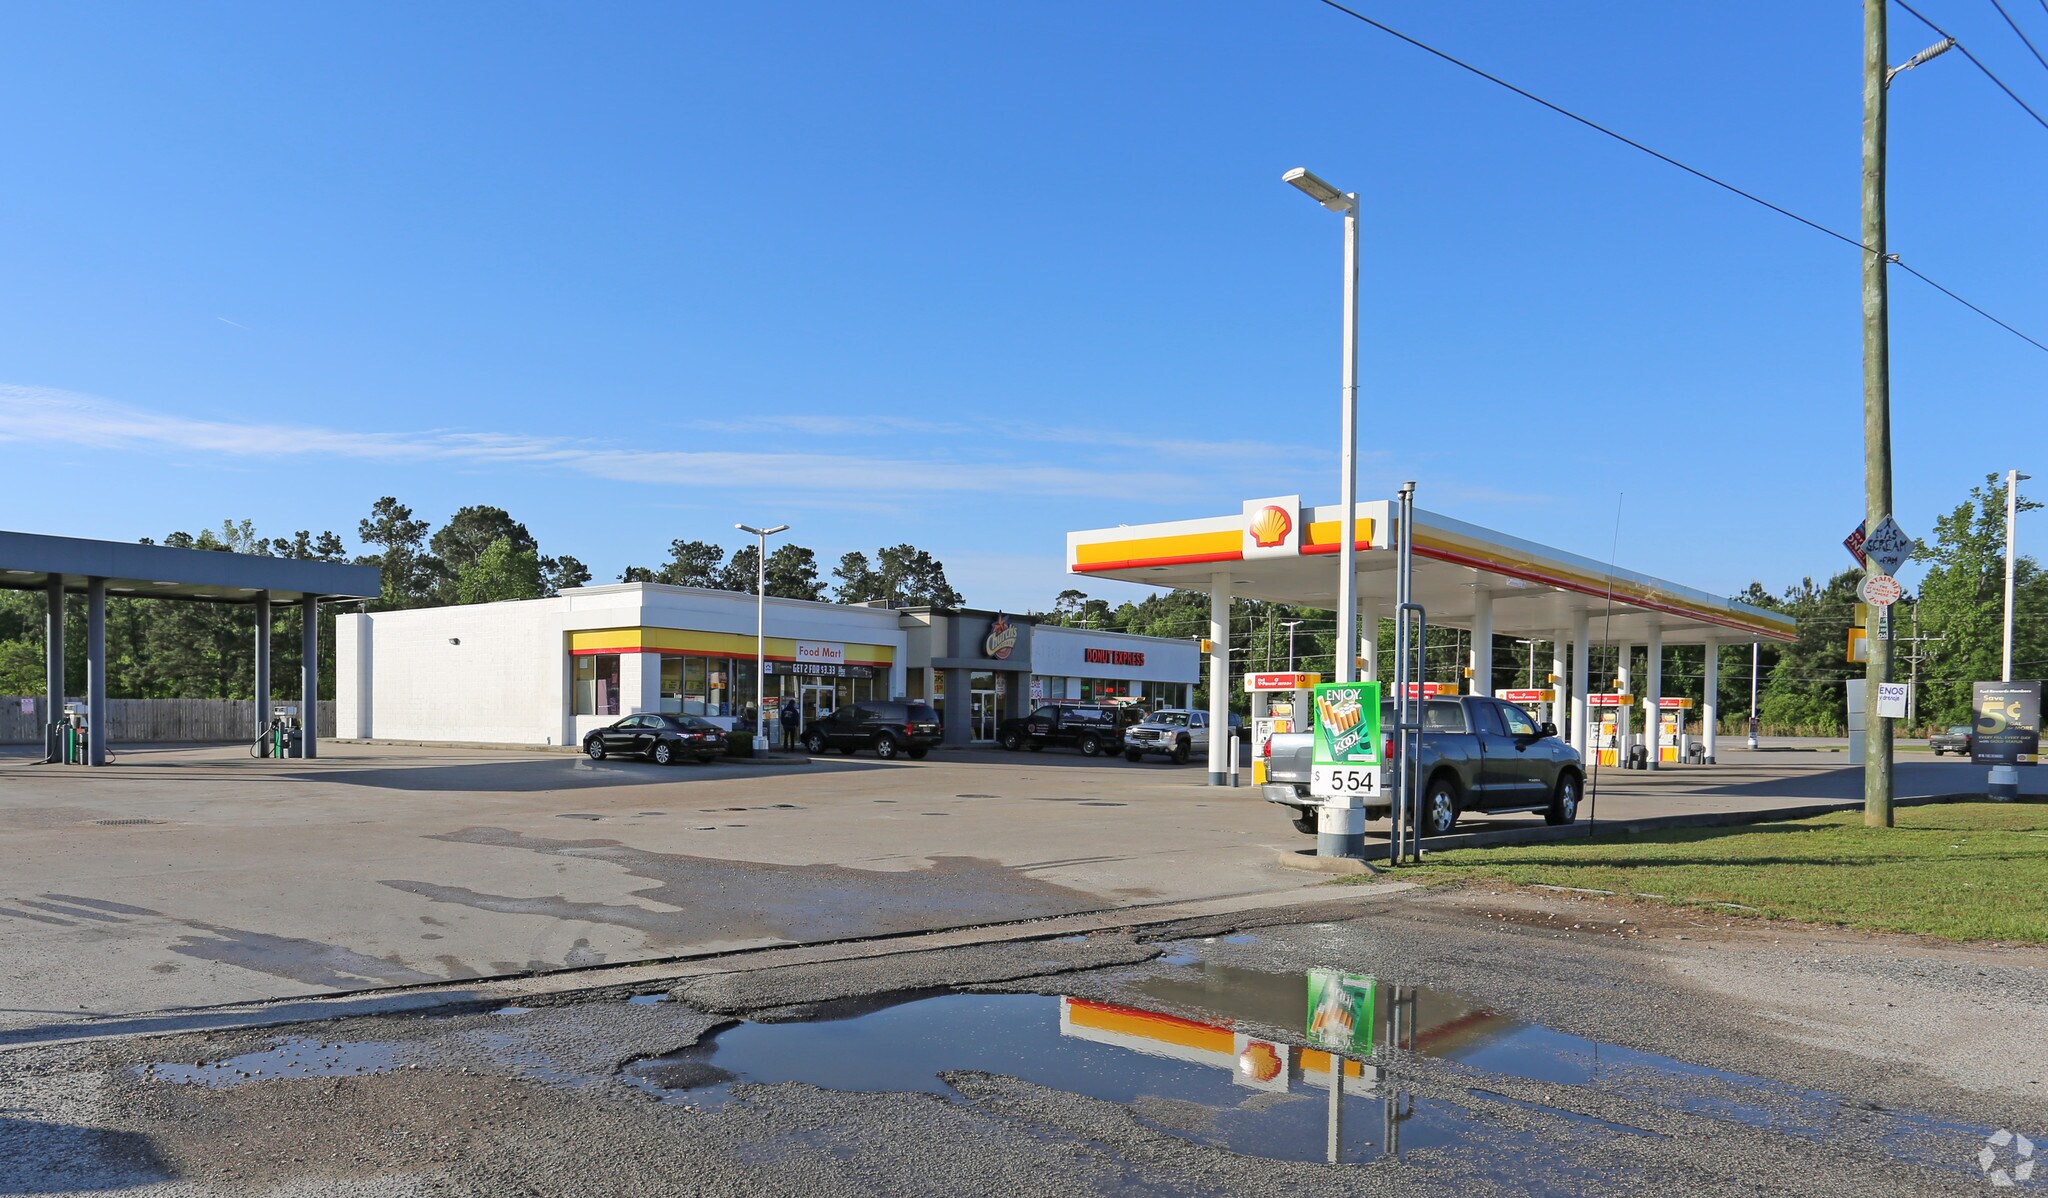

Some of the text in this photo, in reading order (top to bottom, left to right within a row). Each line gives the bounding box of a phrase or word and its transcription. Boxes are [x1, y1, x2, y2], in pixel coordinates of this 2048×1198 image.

[799, 645, 841, 658] Food Mart
[1085, 648, 1145, 666] DONUT EXPRESS
[792, 663, 804, 673] GET
[804, 664, 808, 673] 2
[808, 664, 820, 674] FOR
[1326, 688, 1362, 702] ENJOY.
[1879, 686, 1904, 695] ENOS
[1333, 731, 1362, 754] KOOL
[1315, 771, 1374, 793] $ 5.54
